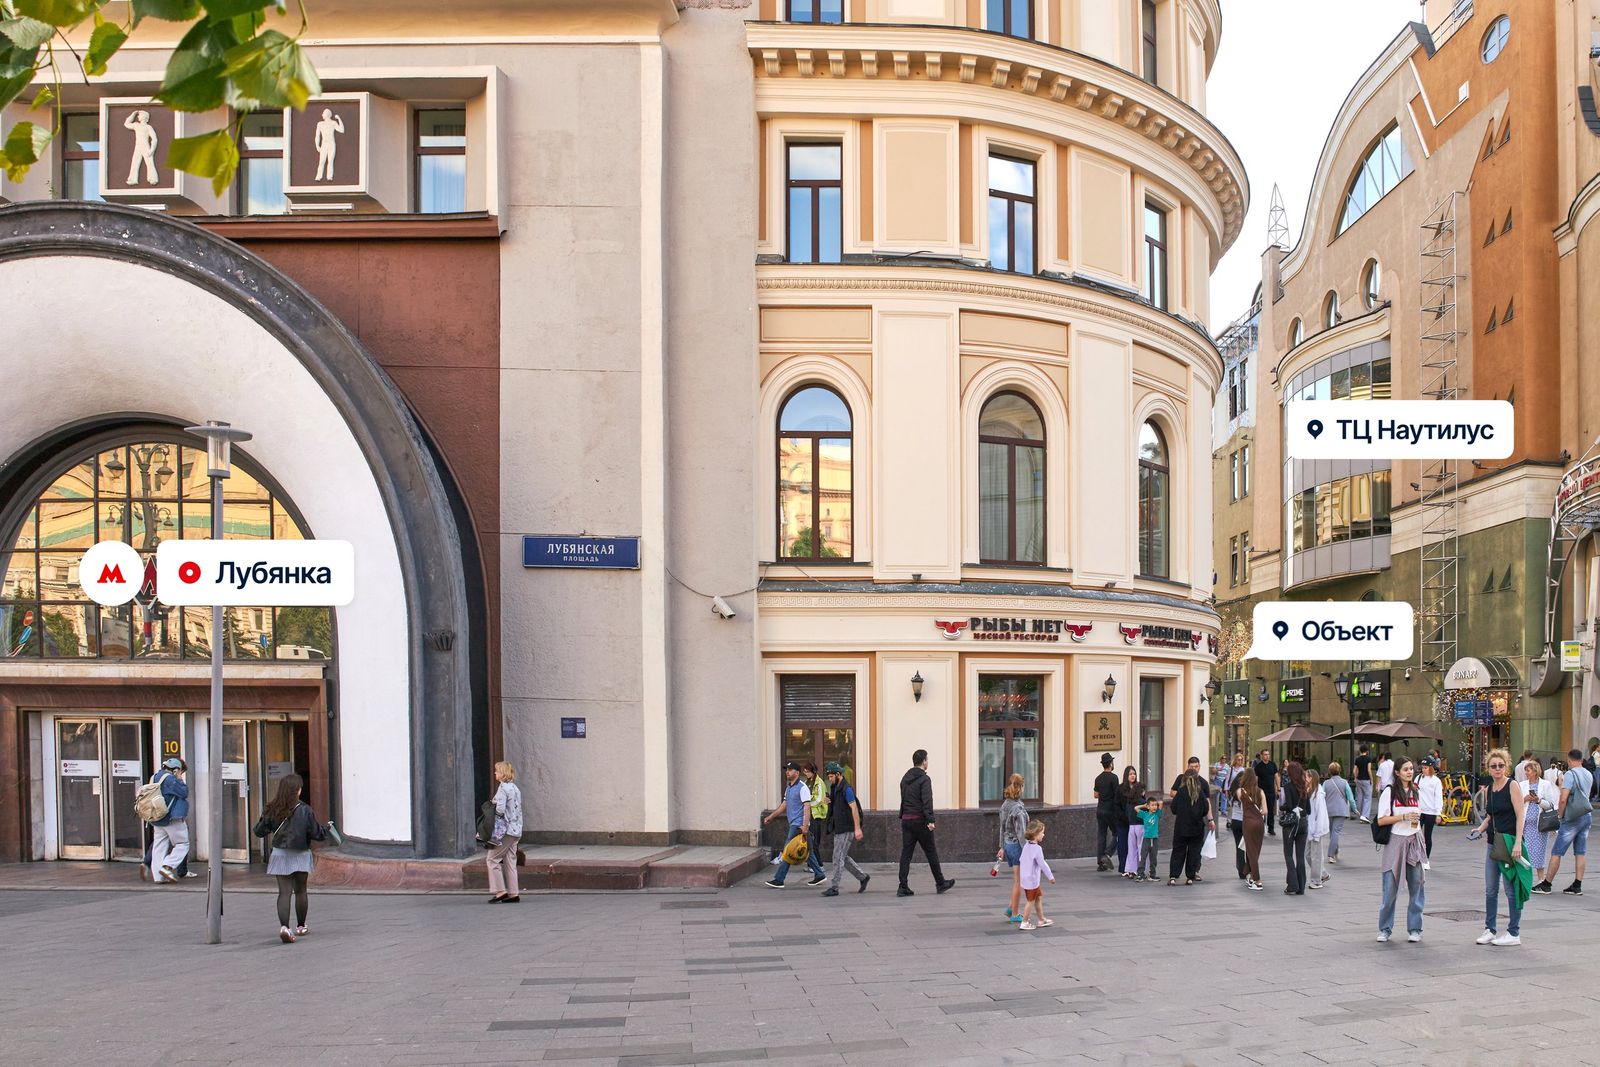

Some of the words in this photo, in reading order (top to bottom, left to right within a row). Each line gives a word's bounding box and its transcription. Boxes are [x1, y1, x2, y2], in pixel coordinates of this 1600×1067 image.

[547, 543, 615, 555] ЛУБЯНСКАЯ
[970, 617, 1026, 632] РЫБЫ
[1032, 619, 1063, 633] НЕТ
[973, 632, 1011, 640] МЯСНОЙ
[1014, 633, 1059, 641] РЕСТОРАН
[164, 740, 179, 753] 10
